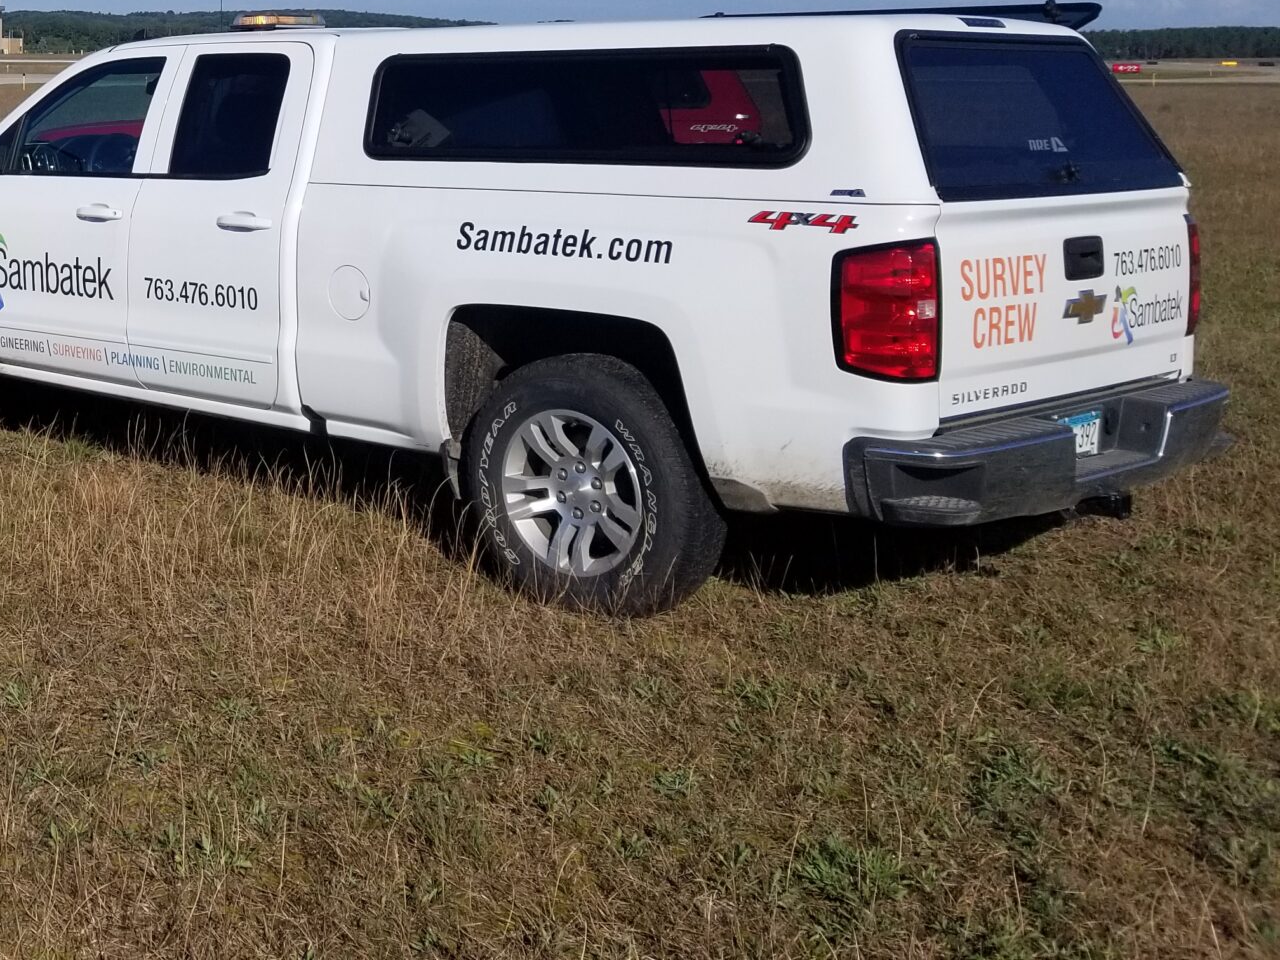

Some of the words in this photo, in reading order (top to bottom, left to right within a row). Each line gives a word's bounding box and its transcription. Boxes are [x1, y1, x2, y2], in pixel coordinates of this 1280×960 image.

[456, 221, 674, 264] Sambatek.com
[1113, 244, 1182, 277] 763.476.6010
[143, 277, 259, 310] 763.476.6010
[960, 253, 1048, 302] SURVEY
[972, 302, 1038, 349] CREW
[1128, 290, 1183, 329] Sambatek
[52, 343, 103, 362] SURVEYING
[110, 351, 160, 371] PLANNING
[169, 360, 258, 385] ENVIRONMENTAL
[951, 381, 1028, 406] SILVERADO
[1078, 421, 1097, 449] 392
